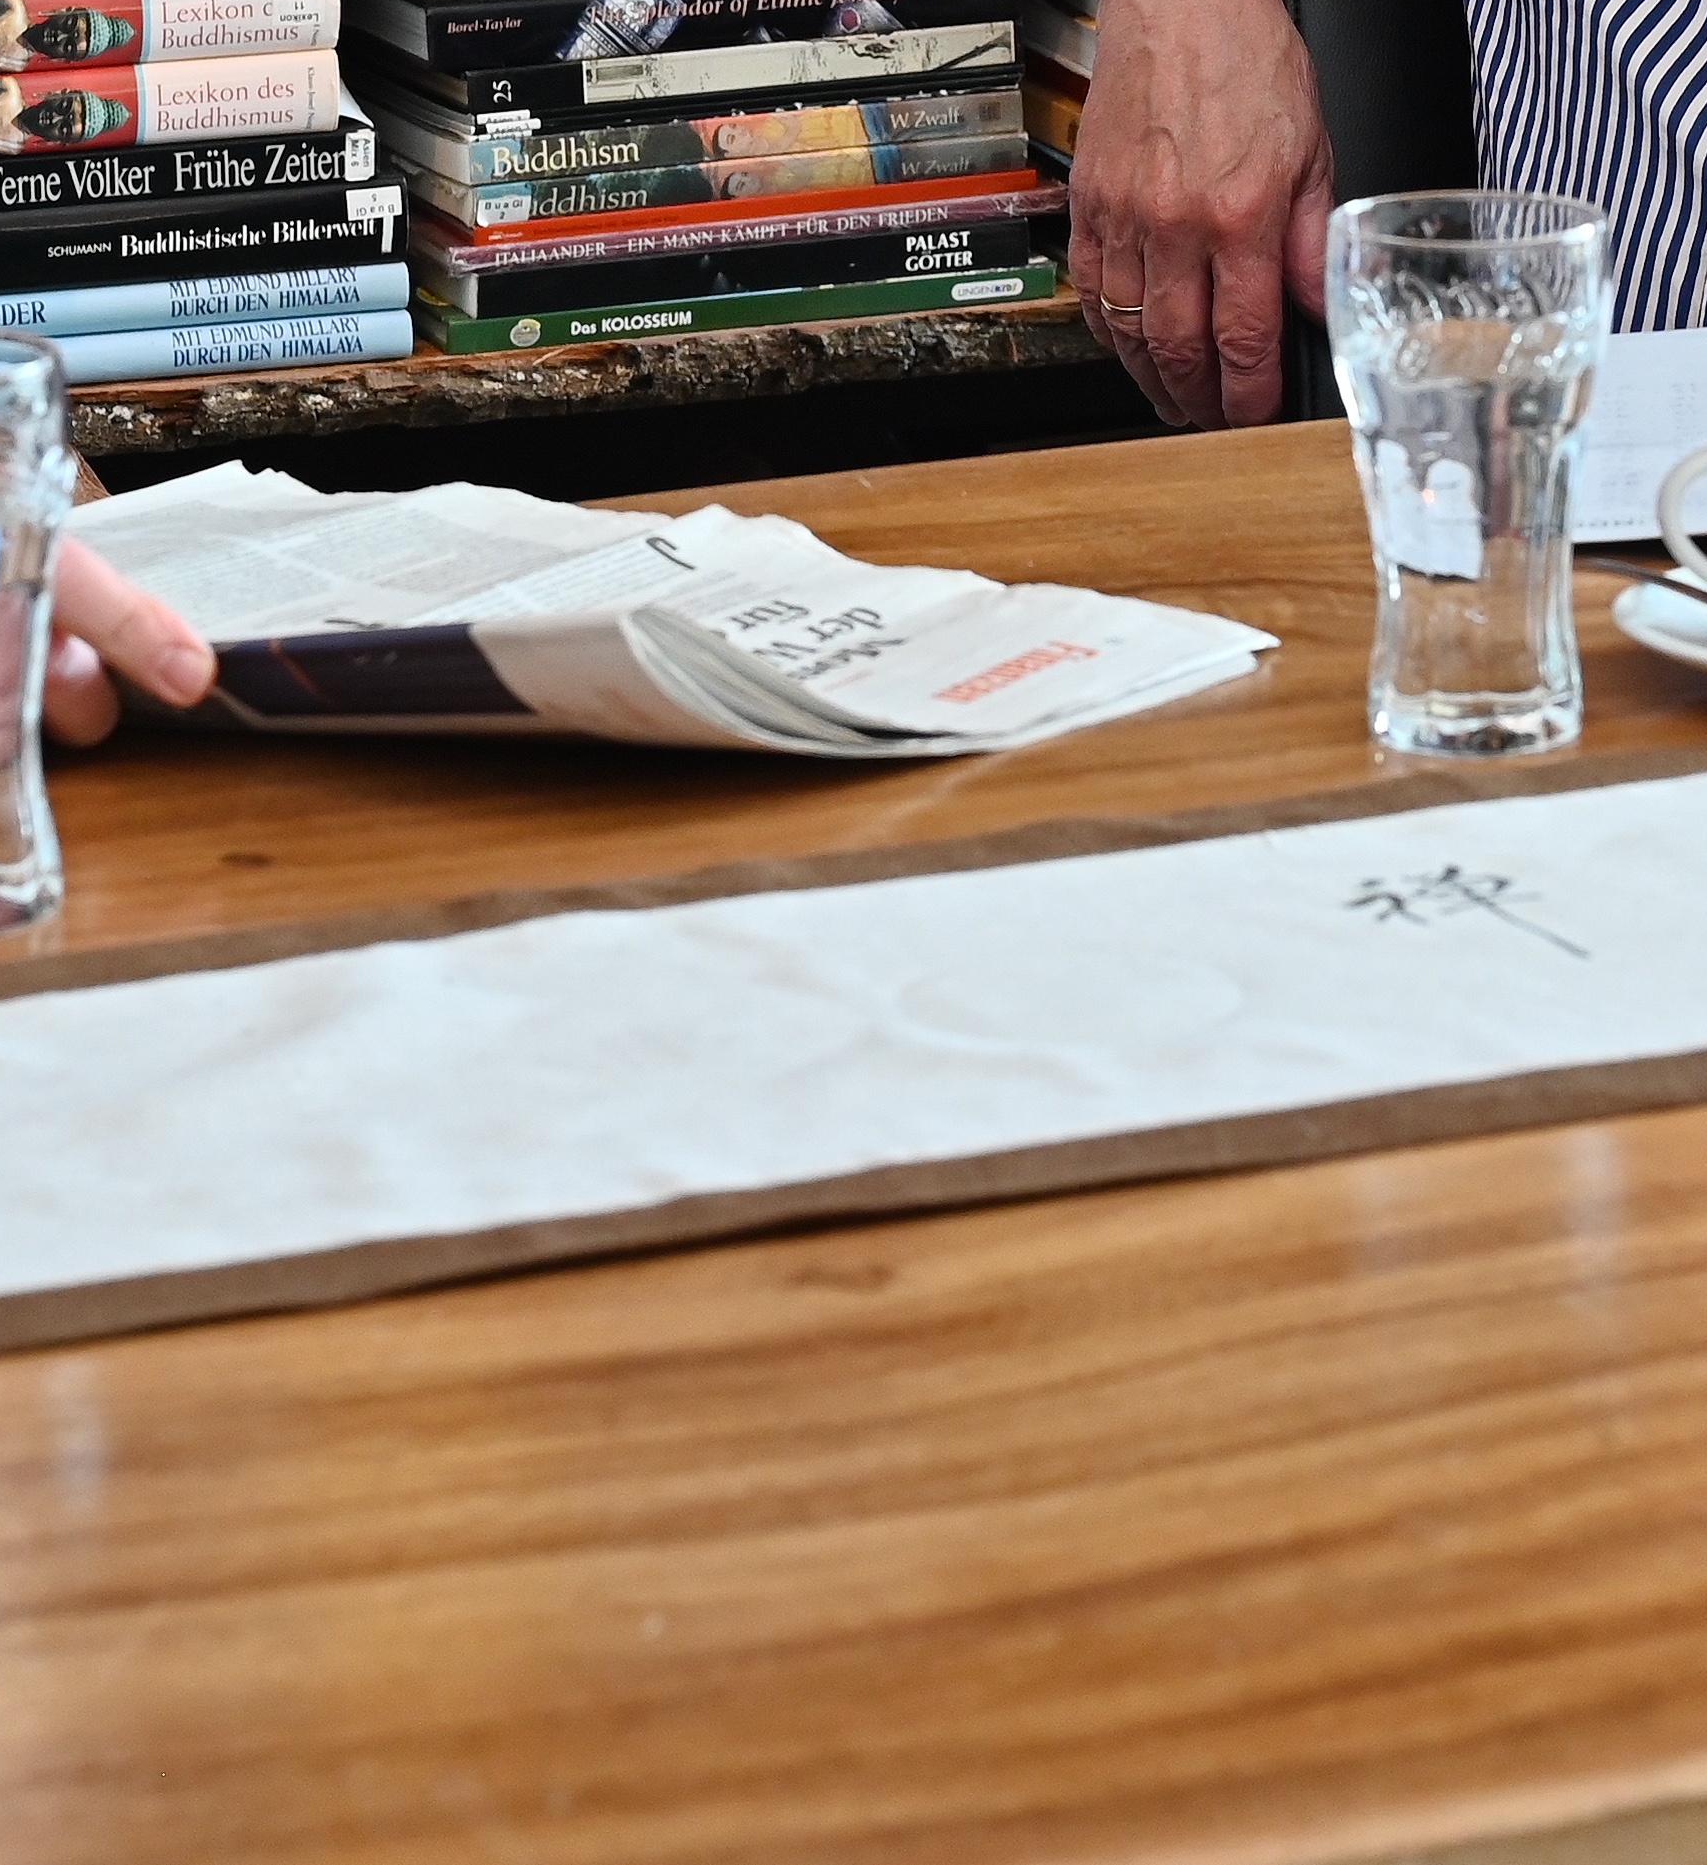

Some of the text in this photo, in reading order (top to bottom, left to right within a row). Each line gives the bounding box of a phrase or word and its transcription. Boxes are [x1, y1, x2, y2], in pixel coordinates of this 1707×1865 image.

[157, 77, 294, 107] Lexikon des
[493, 79, 512, 103] 25
[156, 108, 295, 133] Buddhismus
[914, 107, 960, 127] Zwalf
[65, 156, 155, 199] Völker
[173, 148, 257, 193] Frühe
[264, 141, 347, 183] Zeiten
[492, 137, 641, 178] Buddhism
[47, 217, 378, 258] SCHUMANN Buddhistische Bilderwelt
[628, 207, 949, 253] EIN MANN KÄMPFT FÜR DEN FRIEDEN
[905, 230, 971, 252] PALAST
[494, 242, 606, 266] ITALIAANDER
[905, 250, 973, 272] GÖTTER
[169, 266, 358, 298] MIT EDMUND HILLARY
[171, 286, 360, 318] DURCH DEN HIMALAYA
[570, 310, 692, 336] Das KOLOSSEUM
[728, 600, 810, 632] für
[807, 607, 884, 641] der
